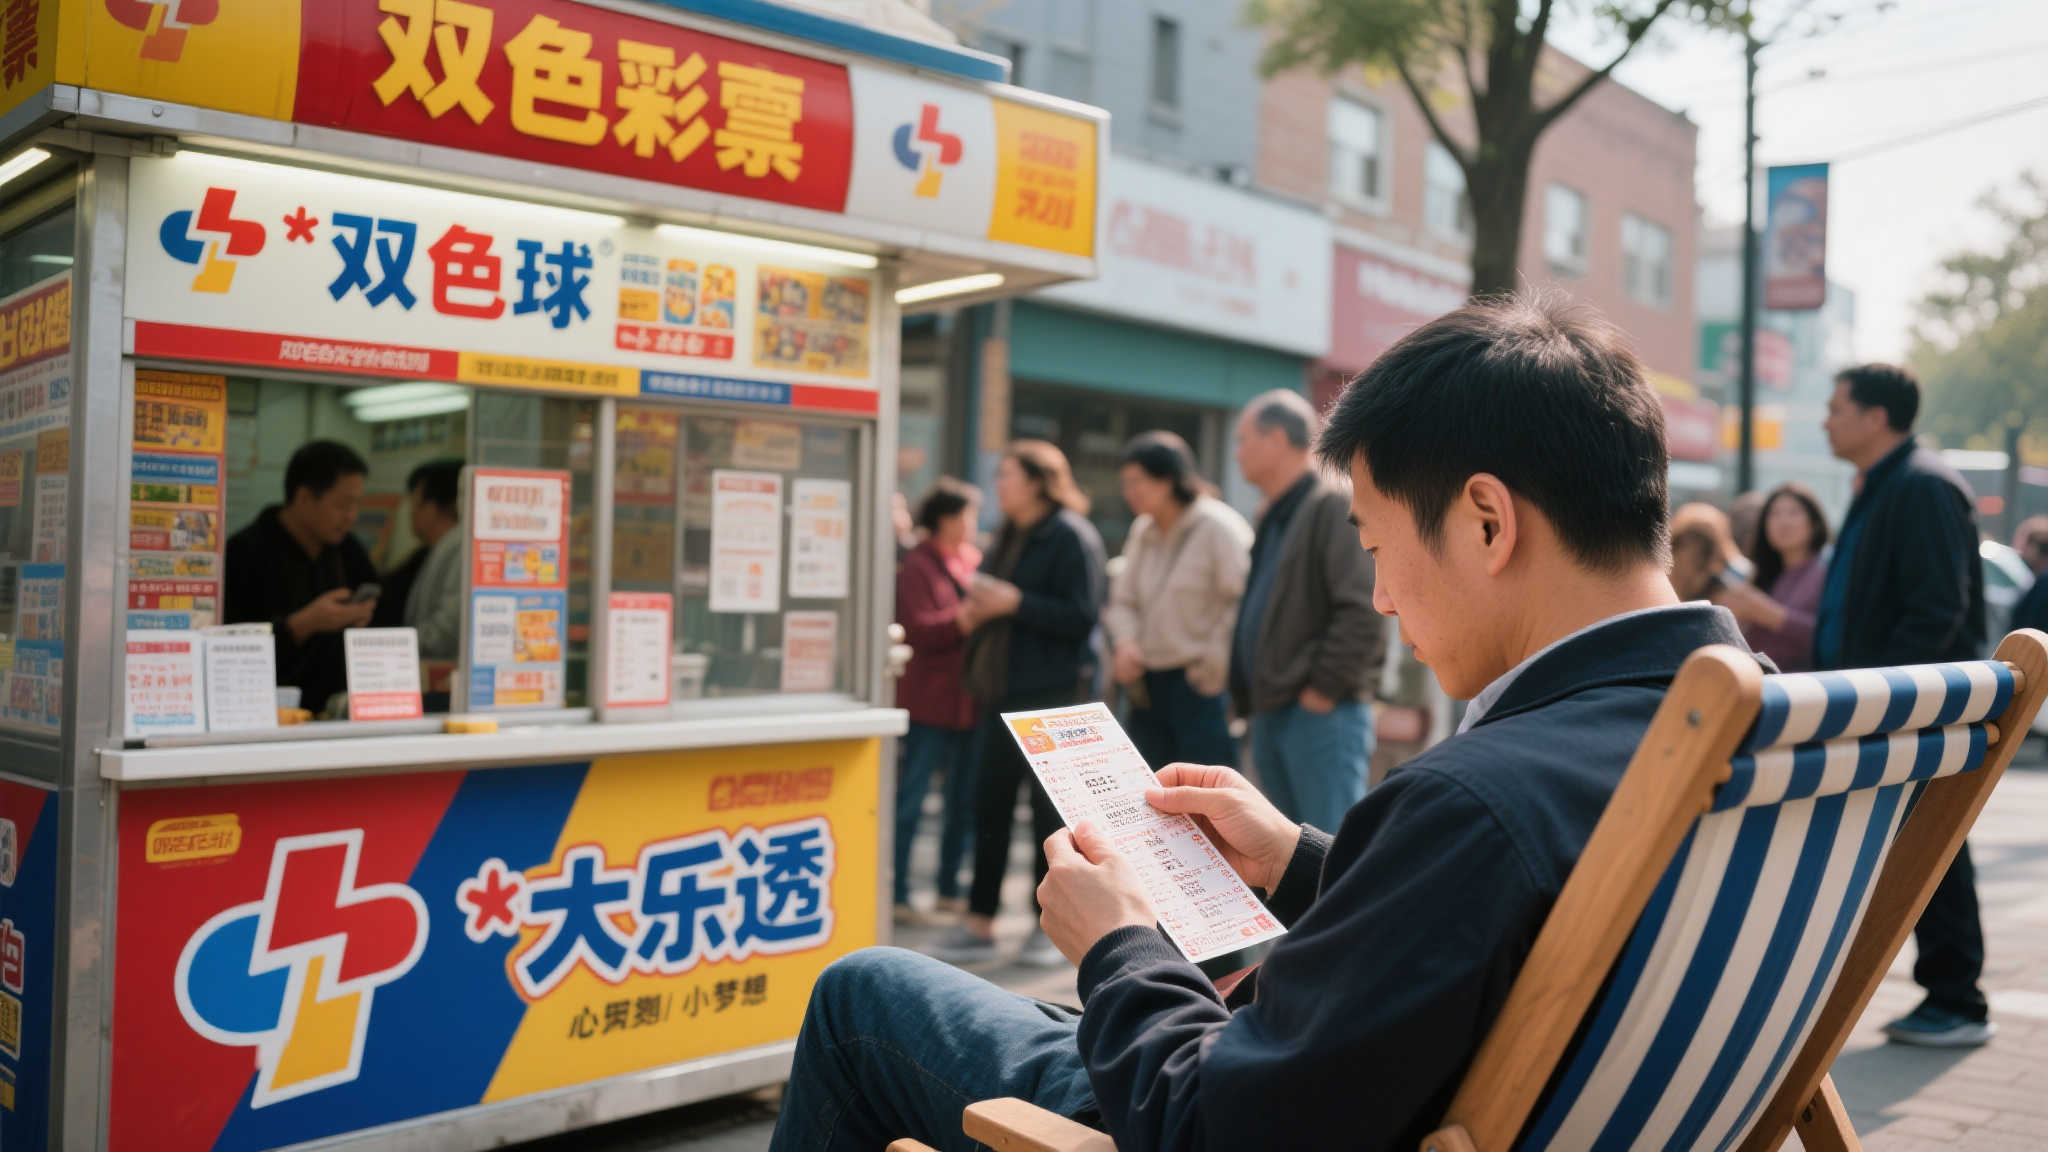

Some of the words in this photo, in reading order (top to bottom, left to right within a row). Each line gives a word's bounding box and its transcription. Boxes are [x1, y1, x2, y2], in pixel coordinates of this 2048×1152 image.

[373, 0, 805, 182] 双色彩票
[328, 212, 594, 329] 双色球
[526, 828, 824, 984] 大乐透
